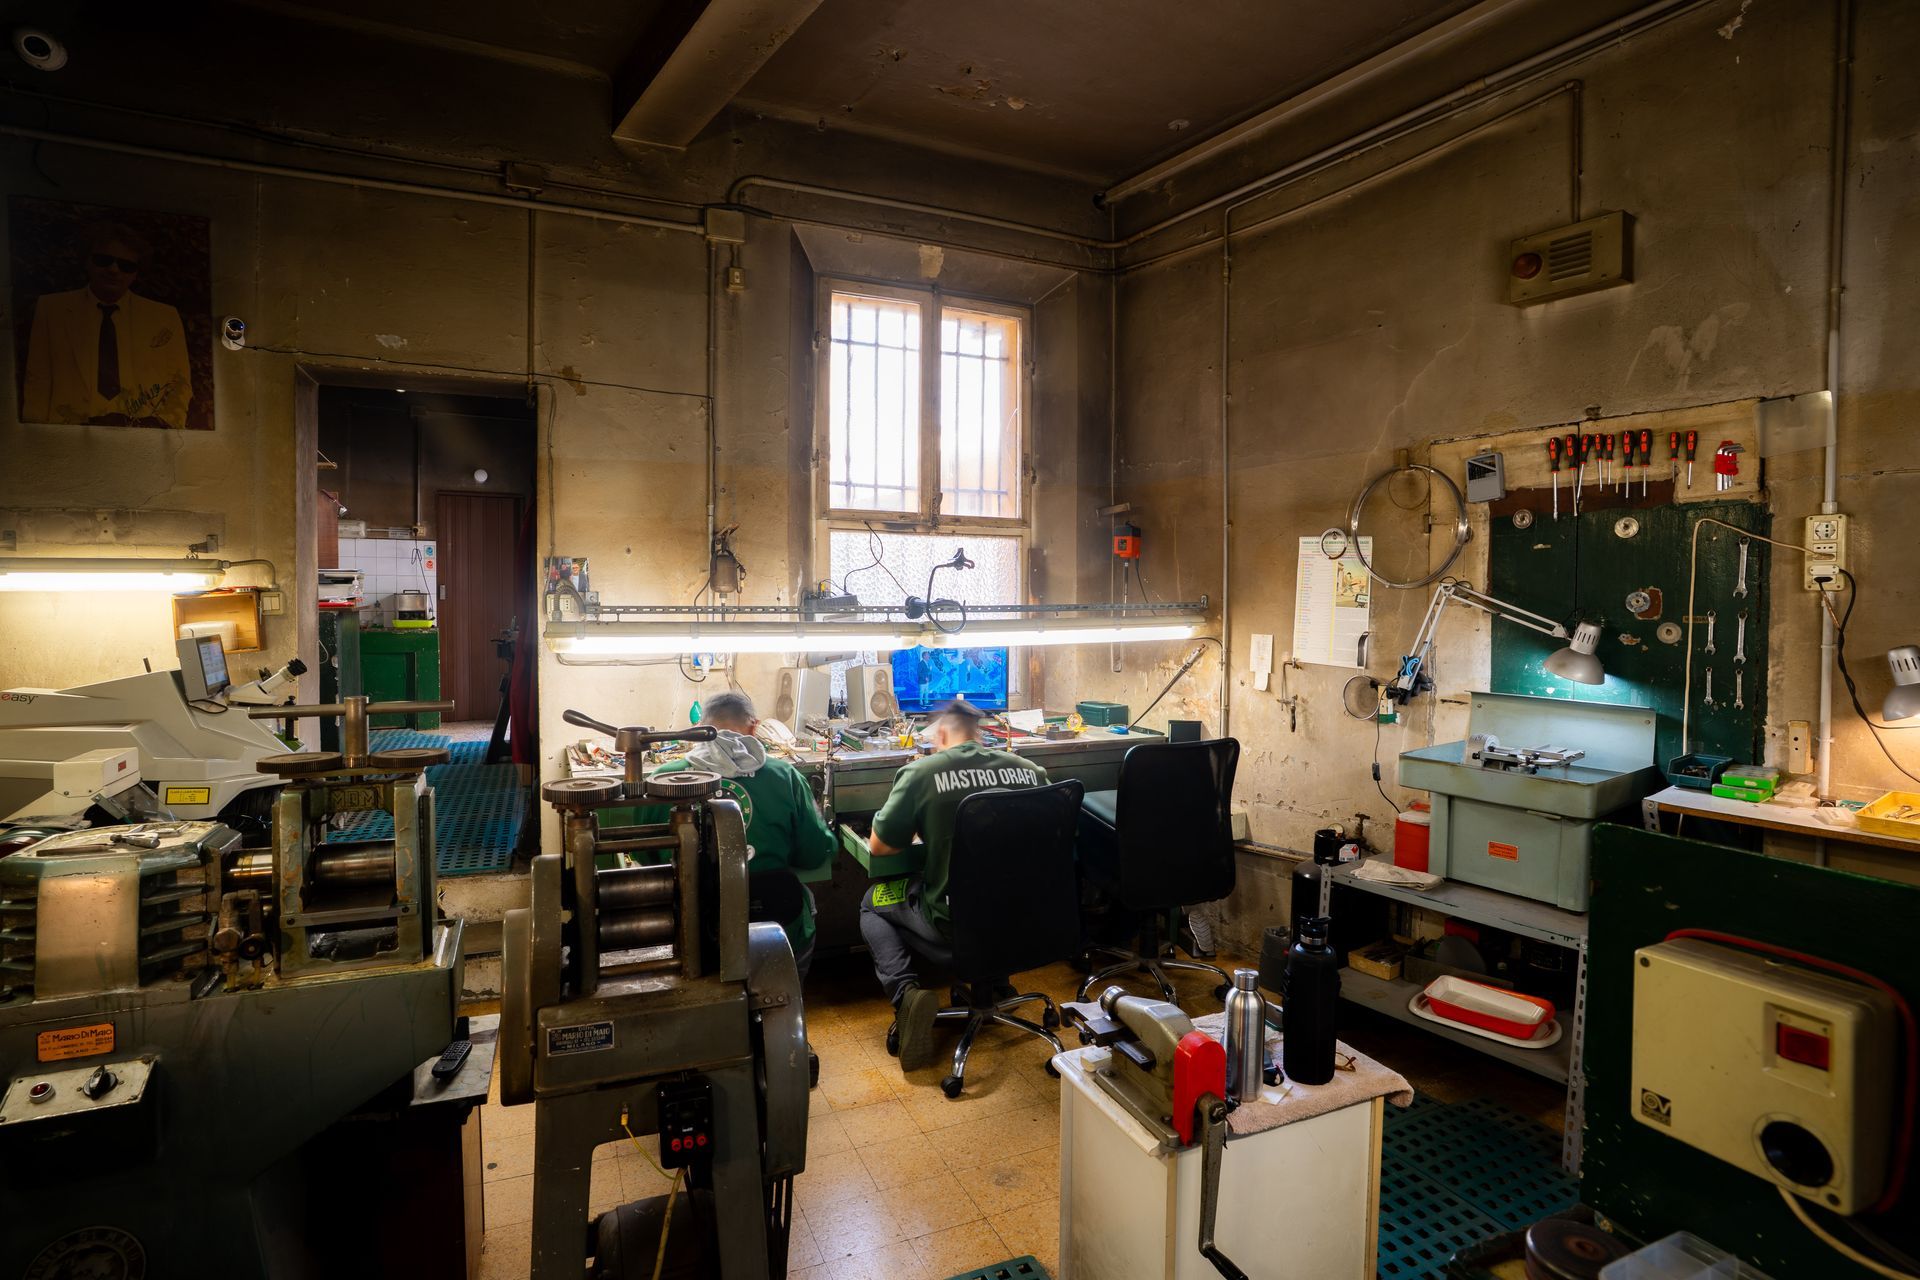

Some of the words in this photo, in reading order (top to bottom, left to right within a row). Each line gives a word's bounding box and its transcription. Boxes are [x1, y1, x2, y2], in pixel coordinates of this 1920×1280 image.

[934, 769, 998, 794] MASTRO
[998, 767, 1038, 786] ORAFO
[562, 1031, 584, 1040] MARIO
[593, 1028, 610, 1036] MAIO
[566, 1041, 596, 1049] MILANO
